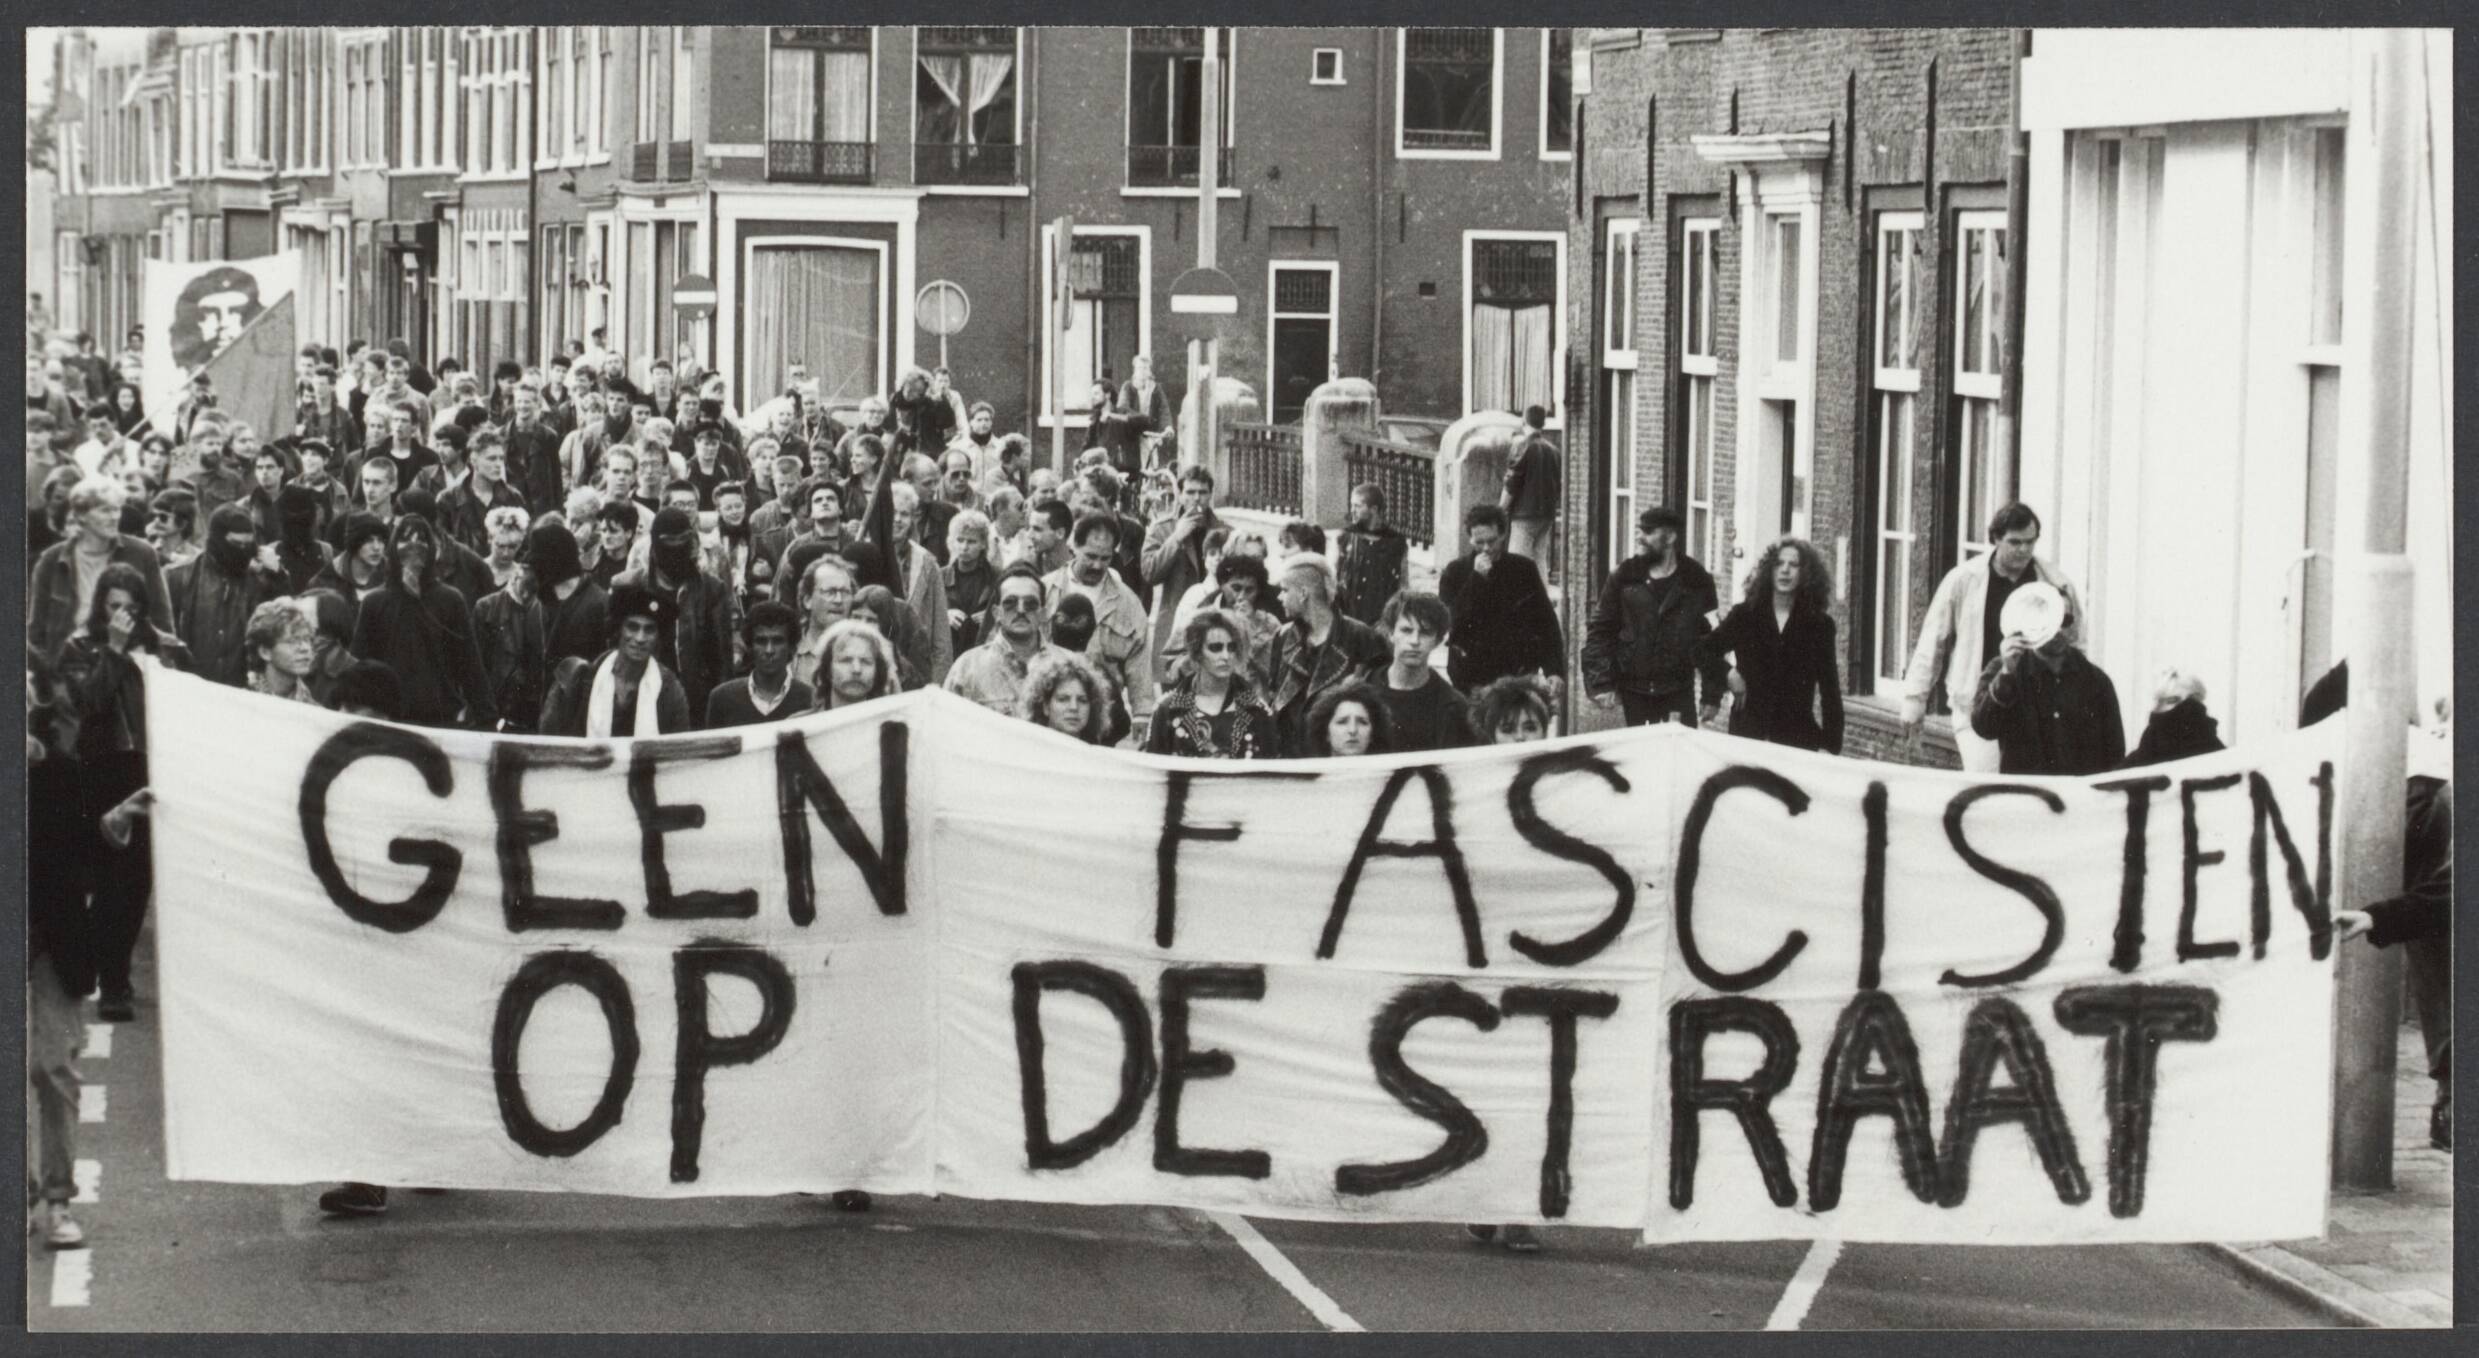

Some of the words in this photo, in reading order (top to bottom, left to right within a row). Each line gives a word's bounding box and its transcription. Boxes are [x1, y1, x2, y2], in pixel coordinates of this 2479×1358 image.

[299, 721, 909, 933] GEEN
[1154, 745, 2336, 991] FASCISTEN
[491, 938, 797, 1183] OP
[1011, 959, 1271, 1180] DE
[1335, 980, 2220, 1219] STRAAT
